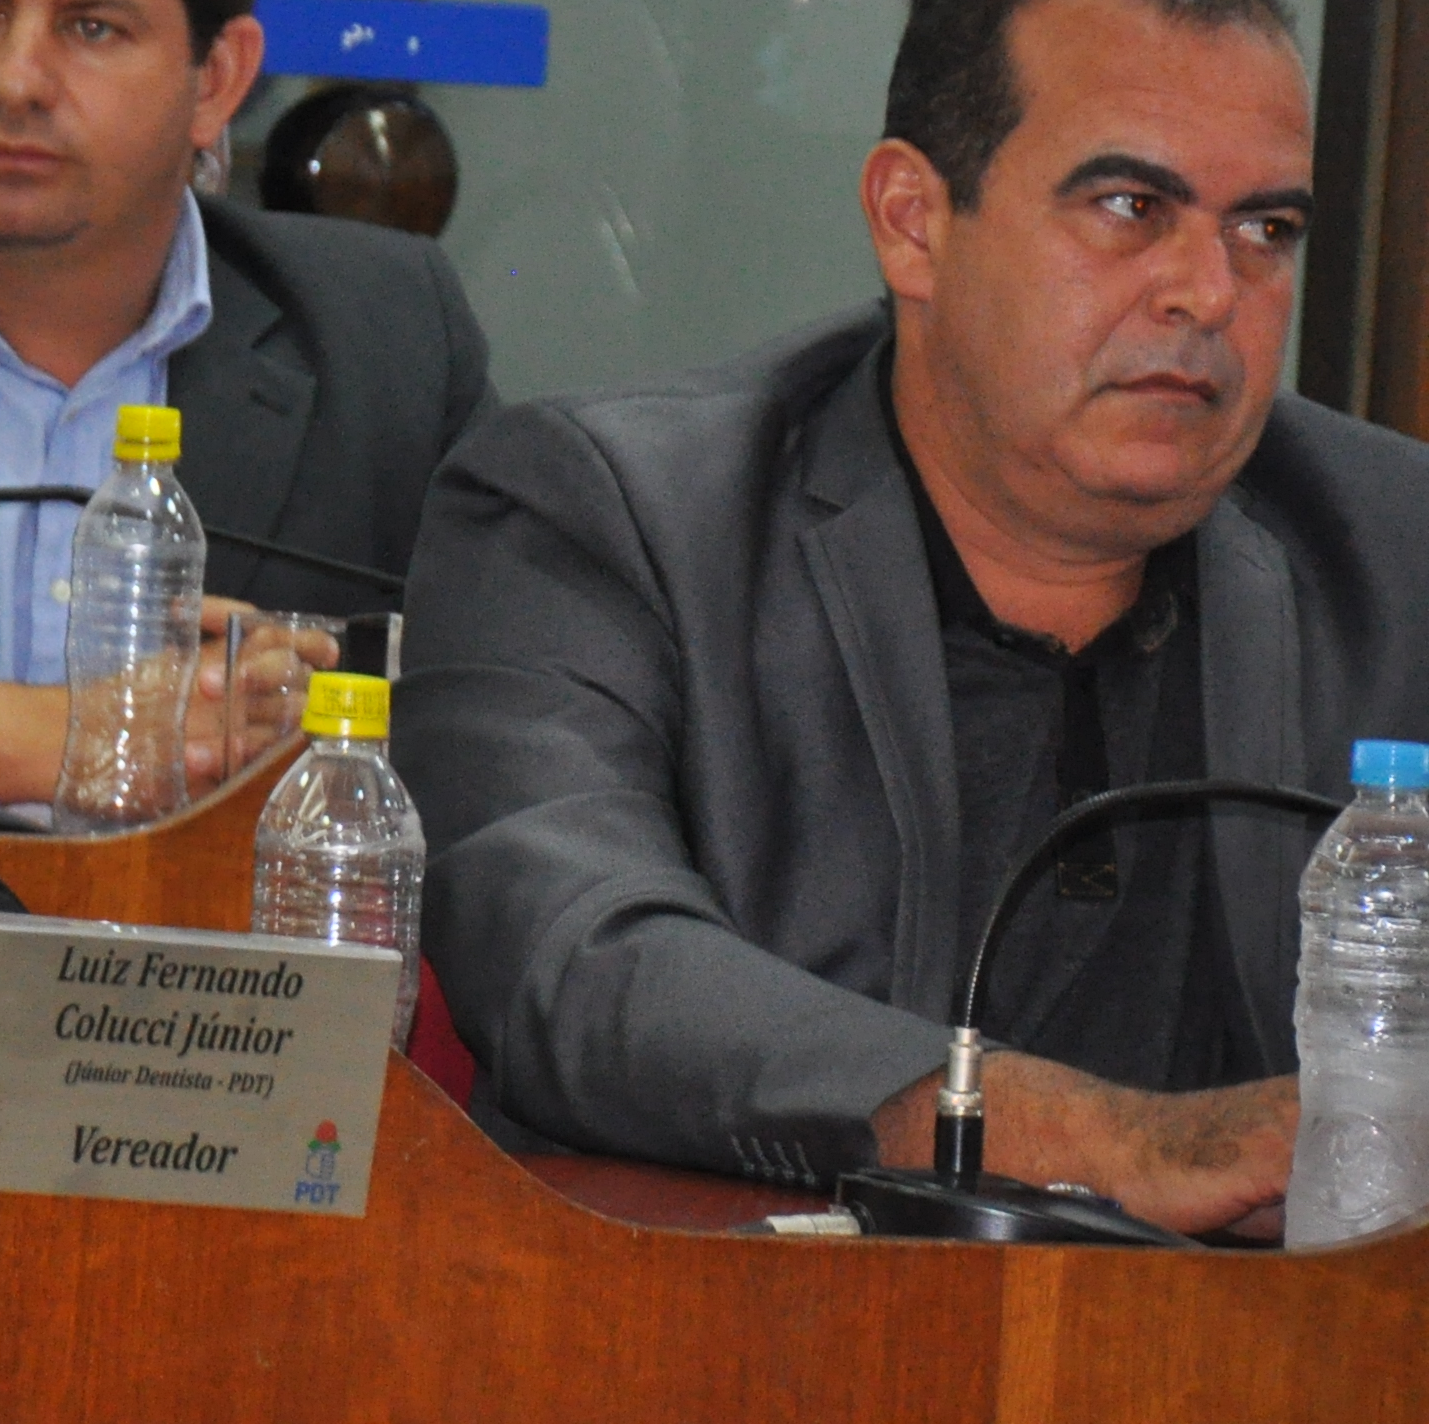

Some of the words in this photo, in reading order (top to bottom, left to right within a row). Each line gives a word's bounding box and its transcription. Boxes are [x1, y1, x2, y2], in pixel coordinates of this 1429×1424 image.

[58, 946, 132, 986] Luiz
[137, 951, 305, 999] Fernando
[55, 1002, 179, 1047] Colucci
[176, 1010, 295, 1059] Júnior
[134, 1064, 213, 1091] Dentista
[227, 1070, 275, 1101] PDT)
[71, 1124, 239, 1174] Vereador
[294, 1180, 341, 1205] PDT
